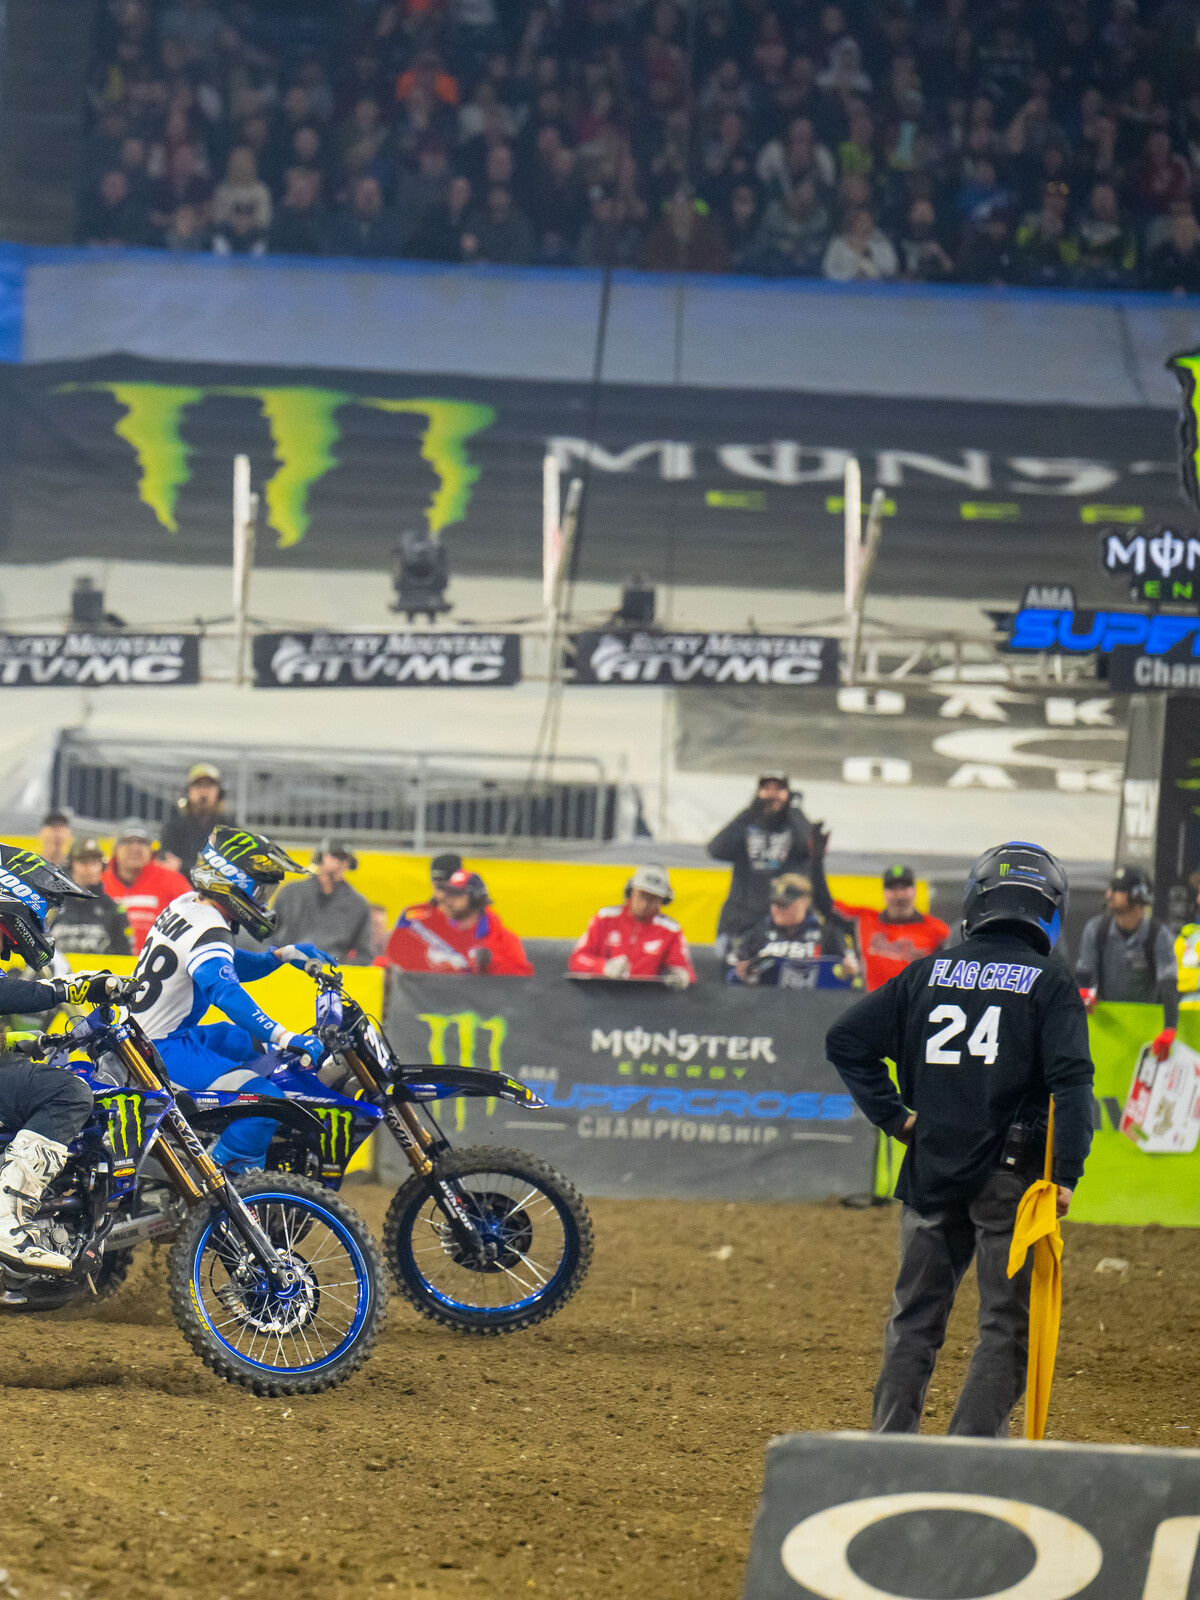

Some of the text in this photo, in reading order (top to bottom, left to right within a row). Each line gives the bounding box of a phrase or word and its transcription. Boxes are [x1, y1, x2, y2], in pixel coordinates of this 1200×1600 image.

[63, 634, 185, 657] MOUNTAIN
[385, 634, 506, 655] MOUNTAIN
[704, 633, 824, 656] MOUNTAIN
[1010, 608, 1200, 659] SUPE
[203, 848, 254, 890] 100%
[928, 959, 1043, 994] FLAG CREW
[591, 1026, 778, 1064] MONSTER
[925, 1004, 1002, 1065] 24
[618, 1061, 748, 1080] ENERGY
[577, 1116, 779, 1143] CHAMPIONSHIP
[439, 1180, 473, 1231] DUNLOP
